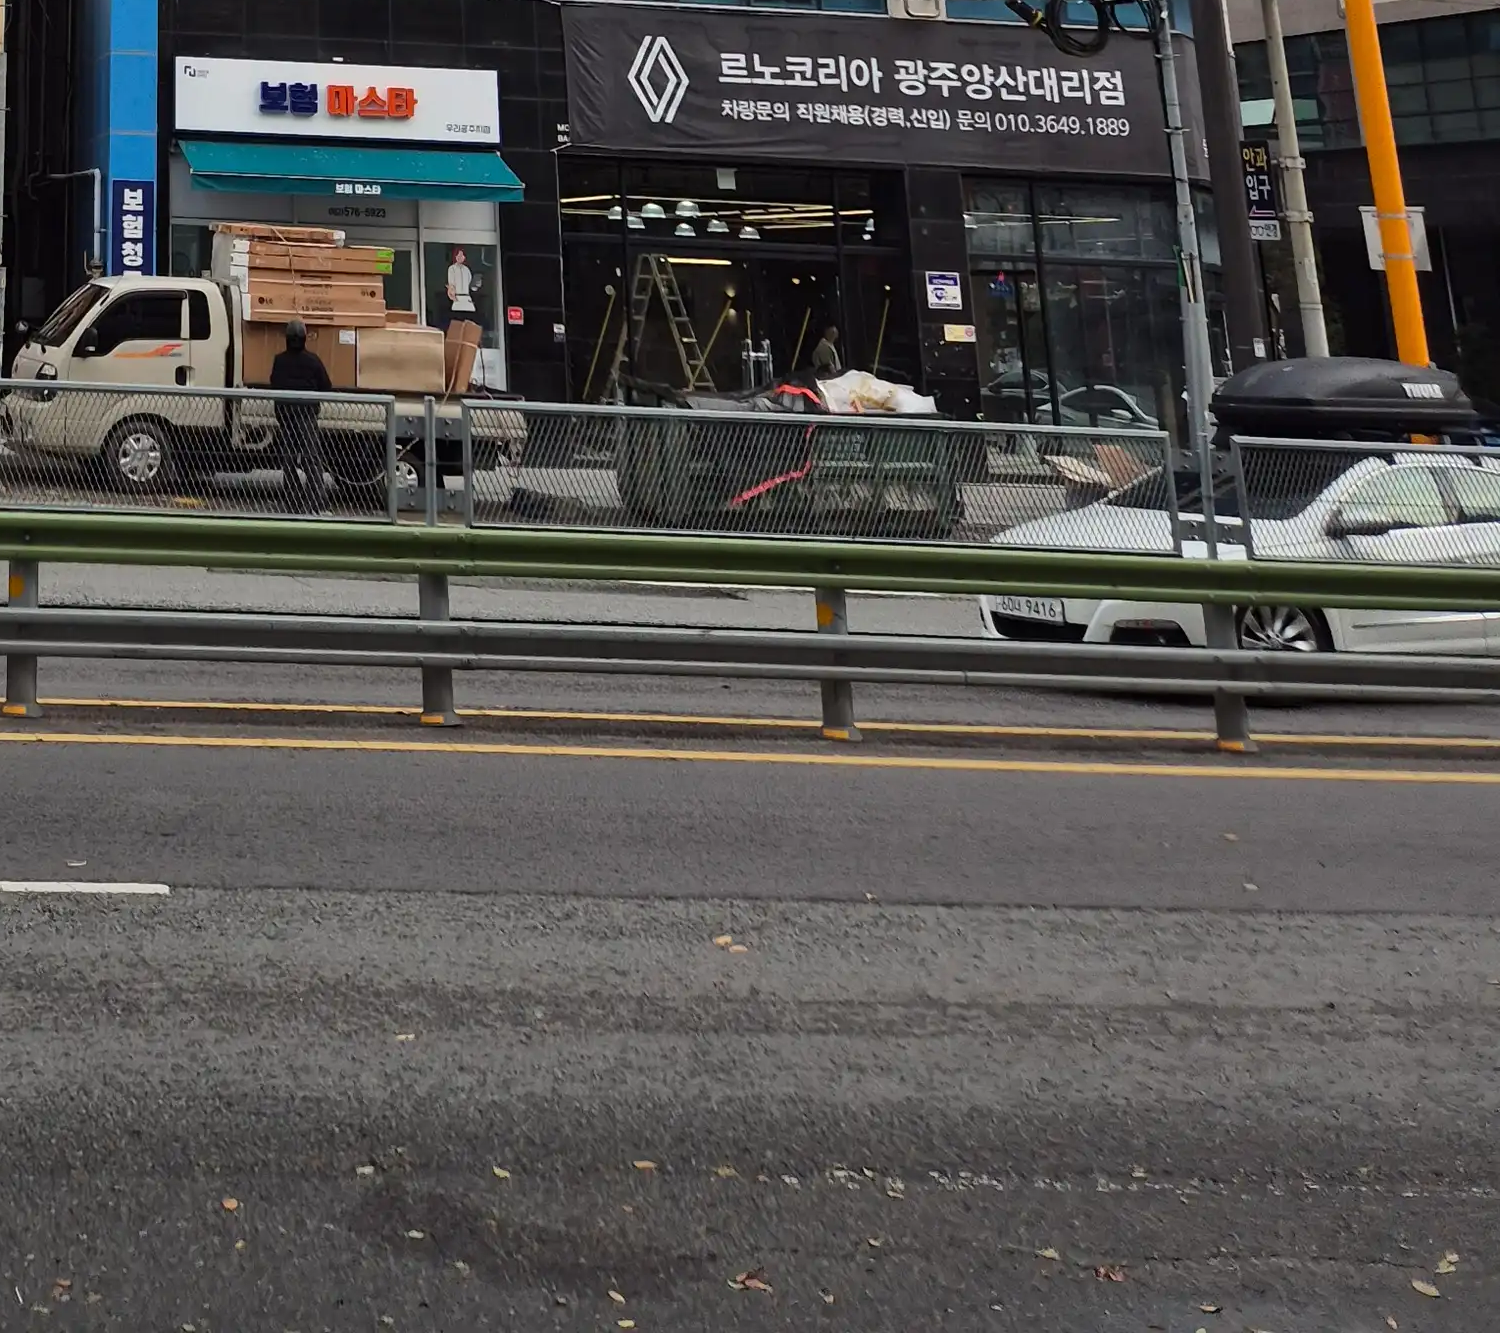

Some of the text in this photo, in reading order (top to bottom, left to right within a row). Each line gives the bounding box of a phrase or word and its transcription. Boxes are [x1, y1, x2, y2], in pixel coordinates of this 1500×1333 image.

[718, 51, 1126, 107] 르노코리아 광주양산대리점
[259, 80, 419, 120] 보험 마스타
[720, 98, 1130, 137] 차량문의 직원채용(경력,신입) 문의 010.3649.1889
[1242, 147, 1268, 173] 안과
[334, 182, 382, 195] 보험 마스타
[1245, 174, 1272, 201] 입구
[121, 187, 145, 277] 보험청
[1025, 598, 1057, 619] 9416
